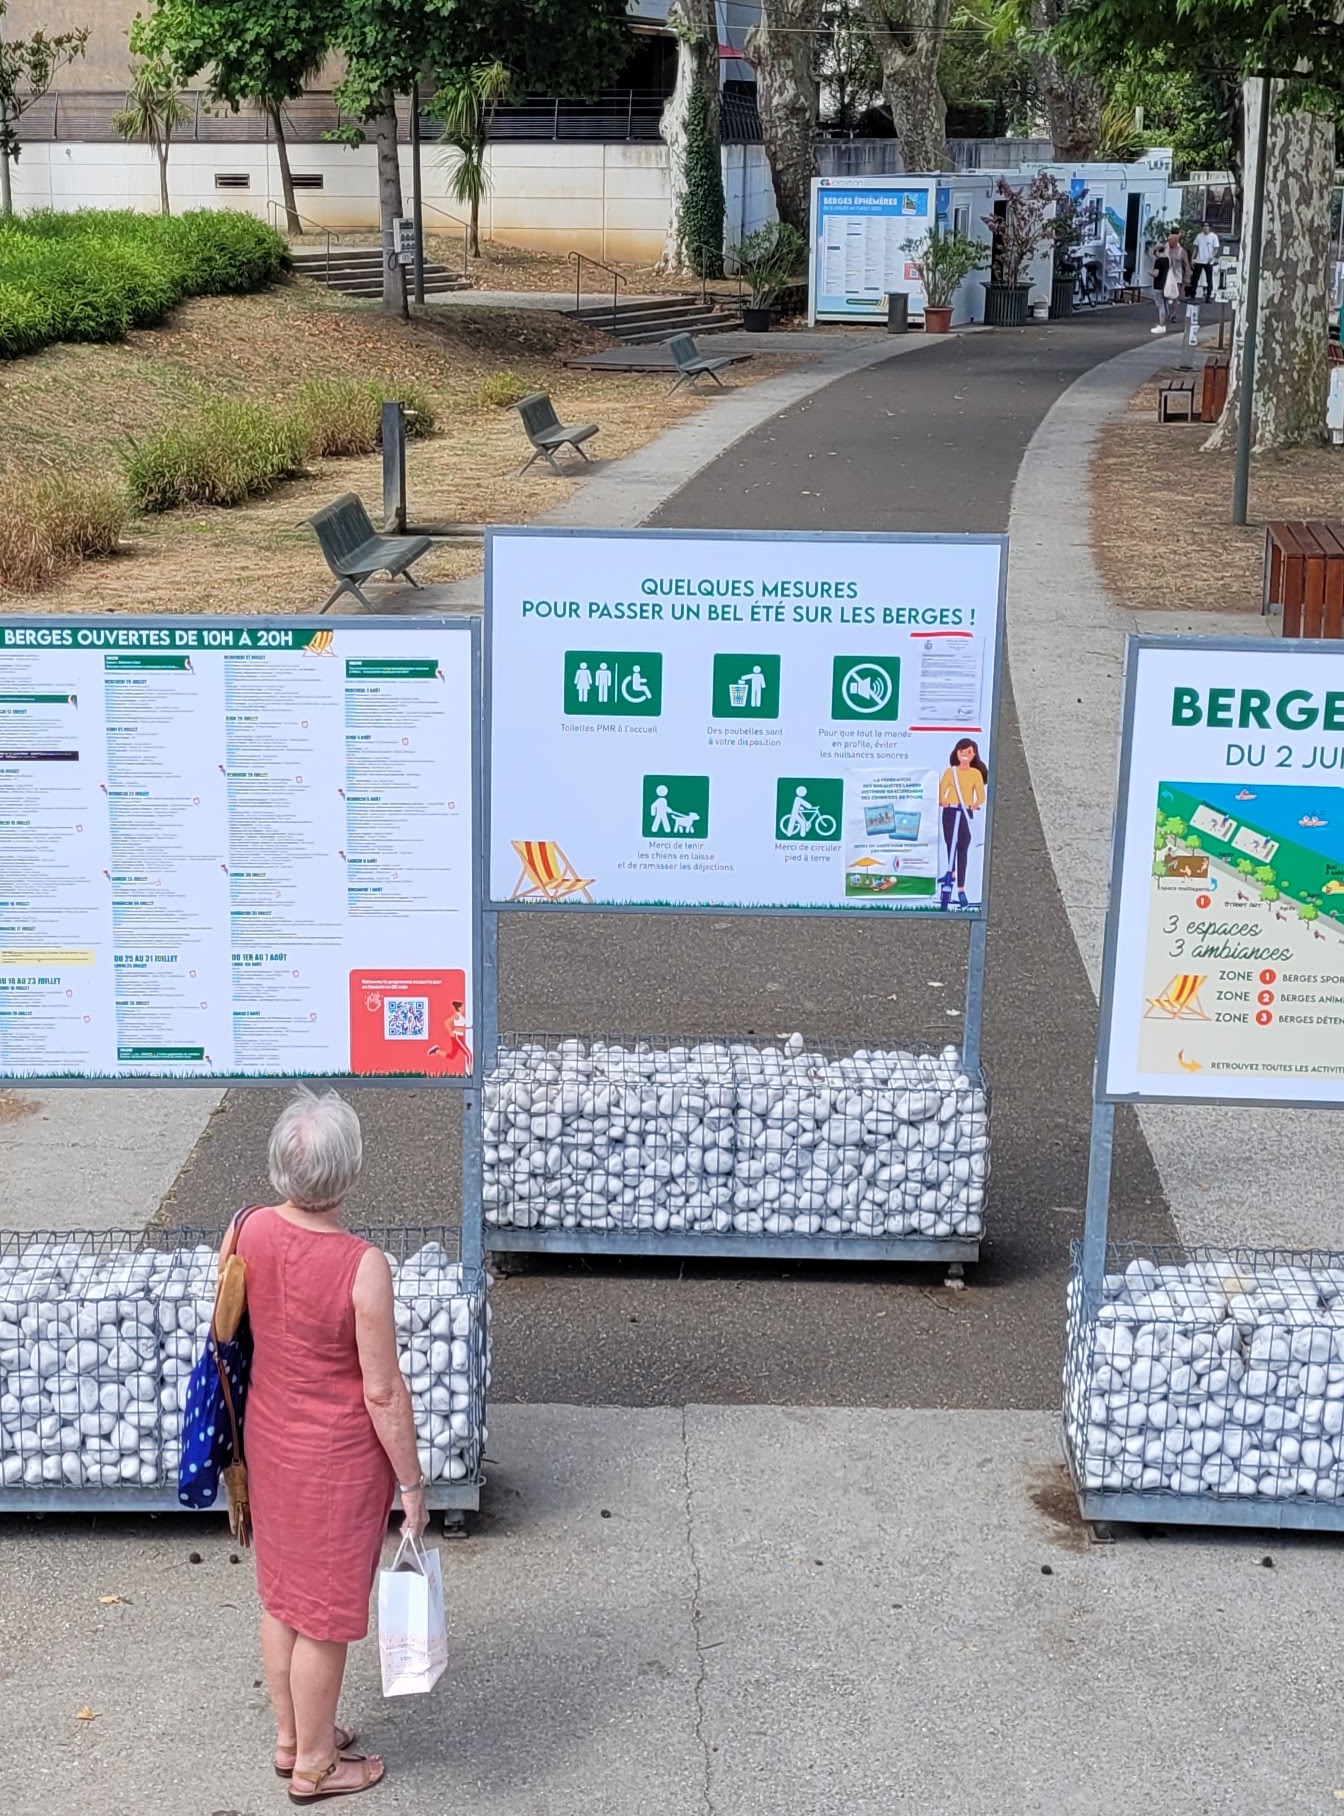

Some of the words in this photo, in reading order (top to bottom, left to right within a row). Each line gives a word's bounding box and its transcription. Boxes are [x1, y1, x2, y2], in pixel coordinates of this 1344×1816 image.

[823, 197, 853, 205] BERGES
[641, 578, 755, 597] QUELQUES
[762, 580, 858, 599] MESURES
[522, 601, 581, 618] POUR
[588, 602, 664, 620] PASSER
[671, 603, 701, 621] UN
[708, 604, 743, 621] BEL
[750, 600, 786, 622] ÉTÉ
[792, 605, 833, 623] SUR
[840, 606, 876, 624] LES
[882, 607, 963, 625] BERGES
[969, 608, 976, 626] !
[4, 629, 72, 645] BERGES
[77, 629, 170, 646] OUVERTES
[176, 630, 197, 646] DE
[202, 631, 233, 646] 10H
[239, 628, 252, 646] À
[257, 630, 293, 646] 20H
[561, 723, 595, 732] Toilettes
[597, 724, 616, 733] PMR
[617, 725, 623, 733] à
[707, 726, 722, 735] Des
[724, 727, 763, 737] poubelles
[765, 728, 783, 736] sont
[818, 728, 837, 737] Pour
[839, 730, 855, 739] que
[857, 729, 873, 738] tout
[874, 729, 882, 738] le
[884, 730, 912, 738] monde
[715, 738, 736, 746] votre
[737, 737, 782, 747] disposition
[874, 741, 898, 749] éviter
[820, 750, 832, 758] les
[834, 751, 875, 759] nuisances
[876, 752, 909, 760] sonores
[1225, 744, 1266, 768] DU
[1276, 745, 1293, 768] 2
[648, 841, 671, 849] Merci
[673, 841, 683, 849] de
[685, 842, 704, 850] tenir
[775, 843, 797, 851] Merci
[799, 843, 809, 851] de
[637, 851, 650, 859] les
[651, 851, 677, 860] chiens
[691, 852, 715, 860] laisse
[784, 854, 802, 863] pied
[803, 854, 808, 862] à
[810, 854, 831, 862] terre
[639, 862, 677, 870] ramasser
[679, 862, 691, 870] les
[693, 863, 734, 872] déjections
[1163, 915, 1179, 934] 3
[1186, 919, 1263, 942] espaces
[1169, 938, 1185, 957] 3
[1191, 939, 1293, 961] ambiances
[1218, 970, 1254, 982] ZONE
[1282, 974, 1318, 983] BERGES
[1216, 990, 1251, 1002] ZONE
[1280, 993, 1316, 1003] BERGES
[1214, 1012, 1249, 1023] ZONE
[1278, 1015, 1314, 1024] BERGES
[1210, 1061, 1259, 1071] RETROUVEZ
[1261, 1063, 1292, 1072] TOUTES
[1294, 1064, 1309, 1073] LES
